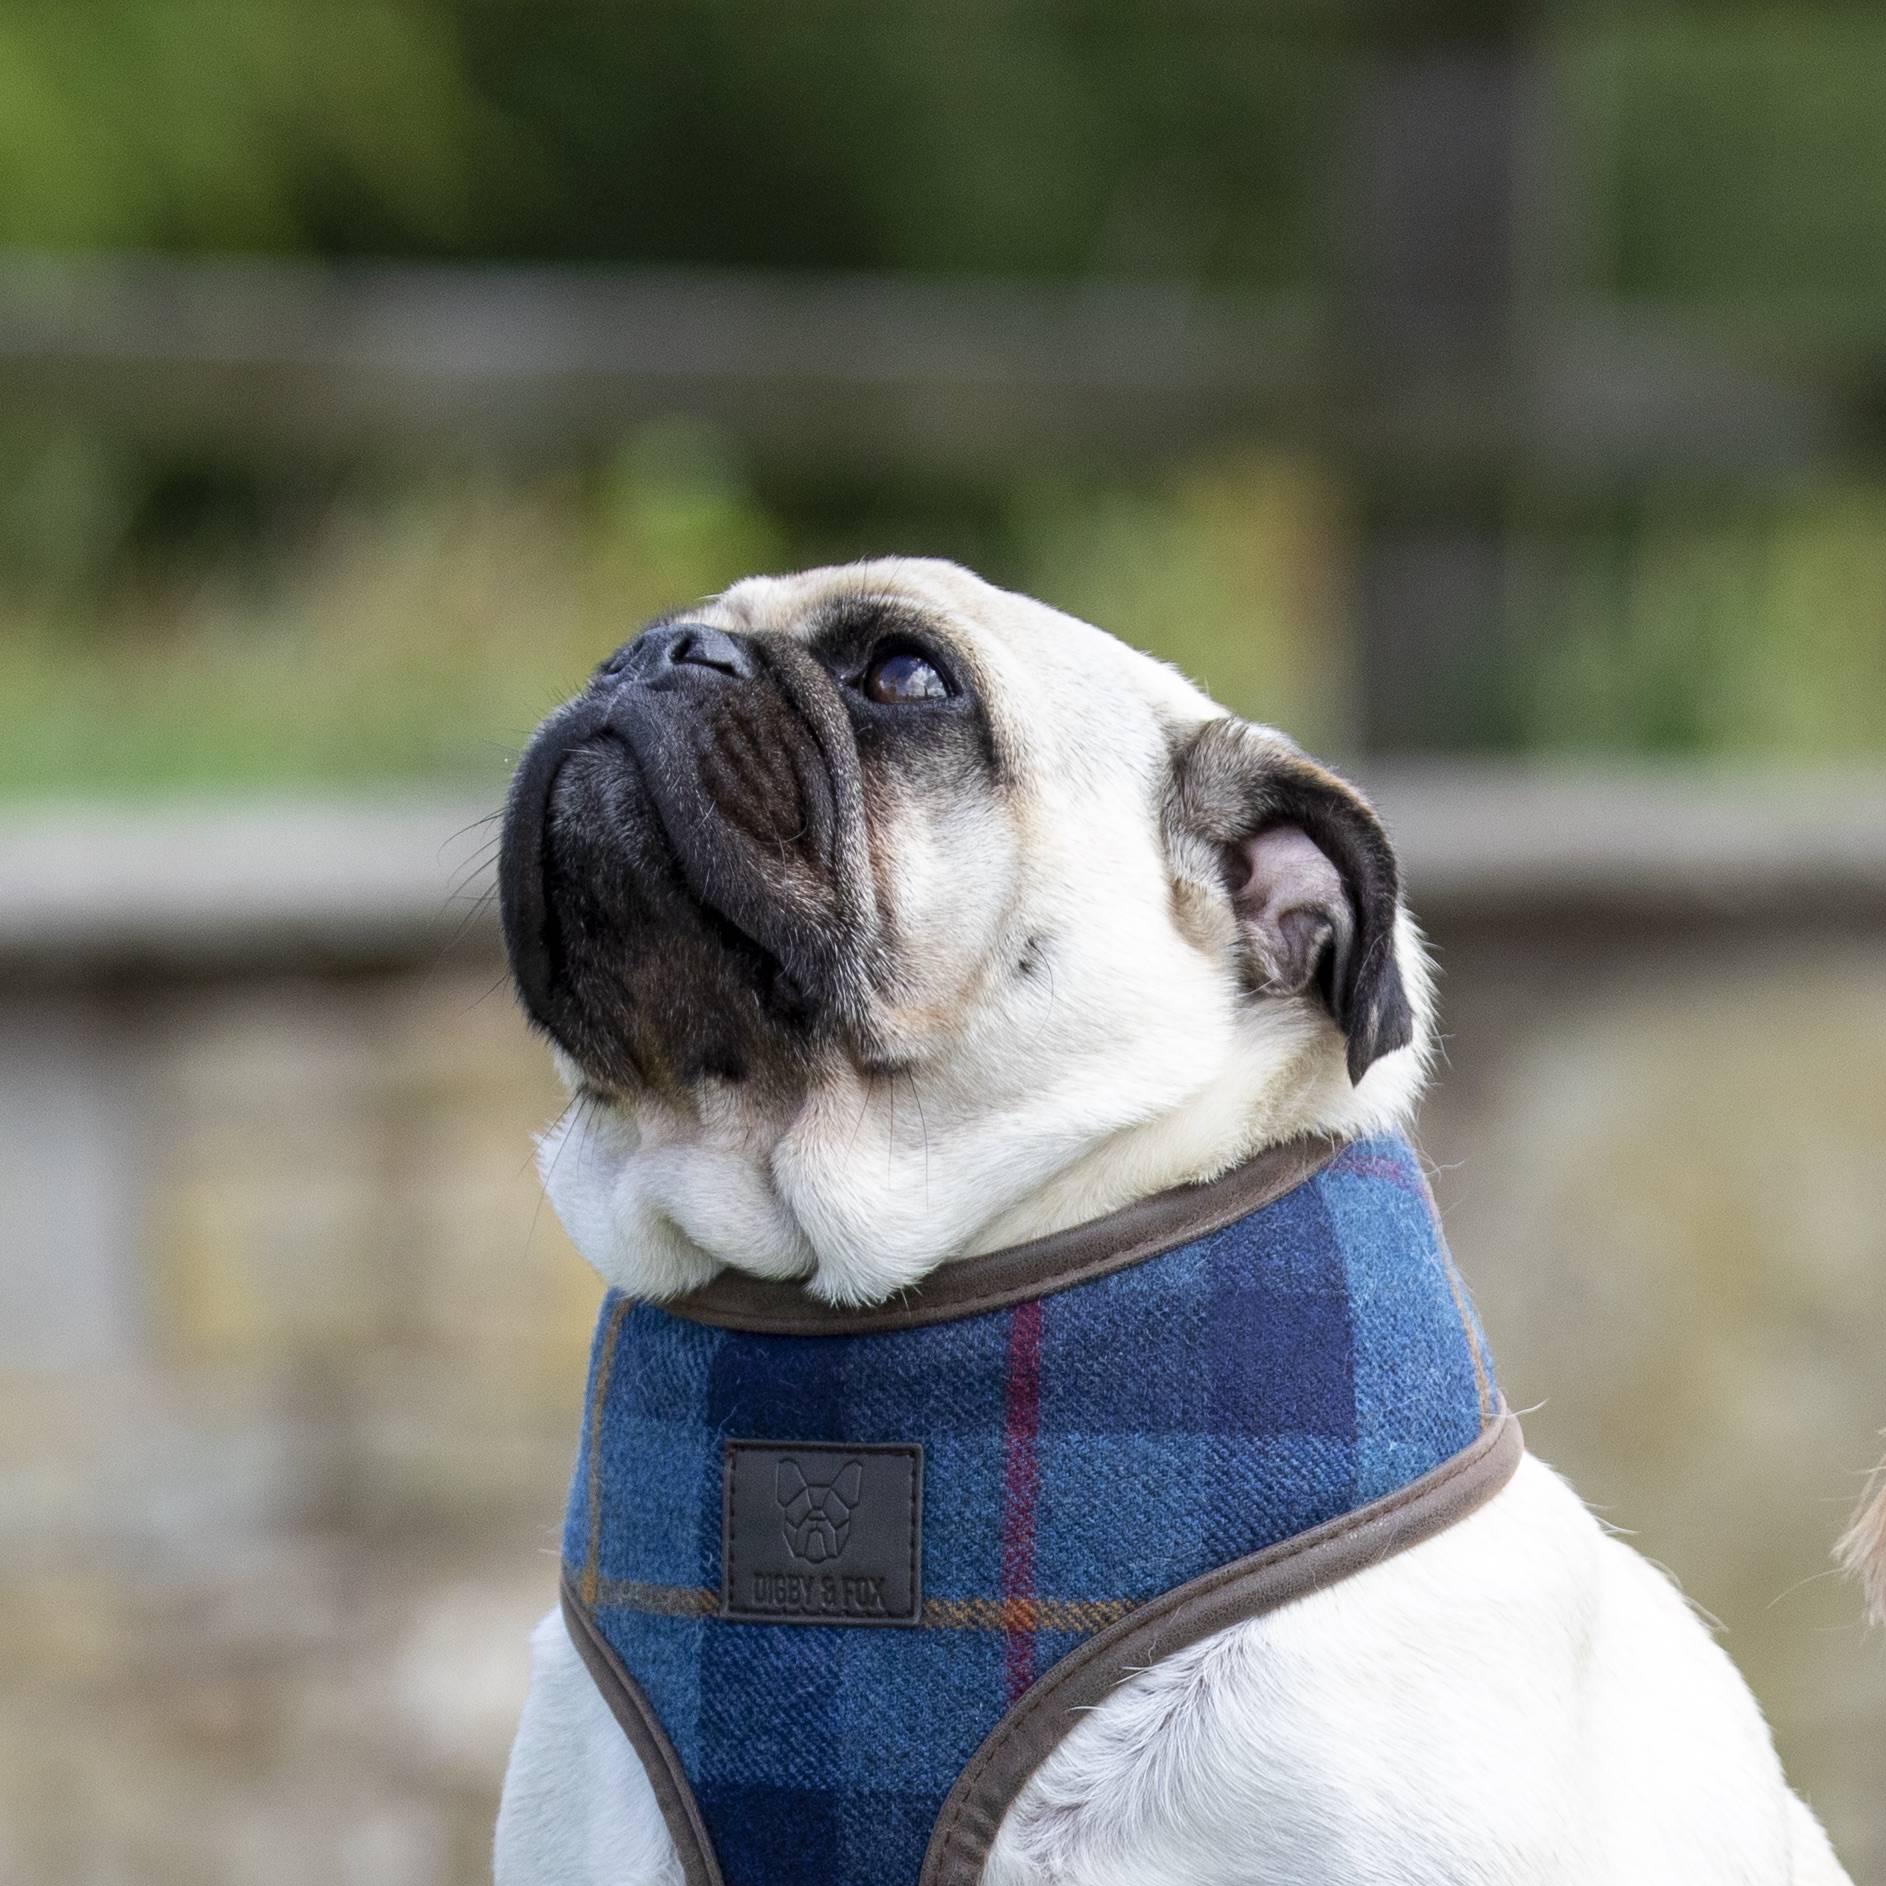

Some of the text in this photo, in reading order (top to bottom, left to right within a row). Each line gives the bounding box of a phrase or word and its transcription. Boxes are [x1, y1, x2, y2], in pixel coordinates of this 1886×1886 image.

[753, 1572, 885, 1610] DIGBY & FOX
